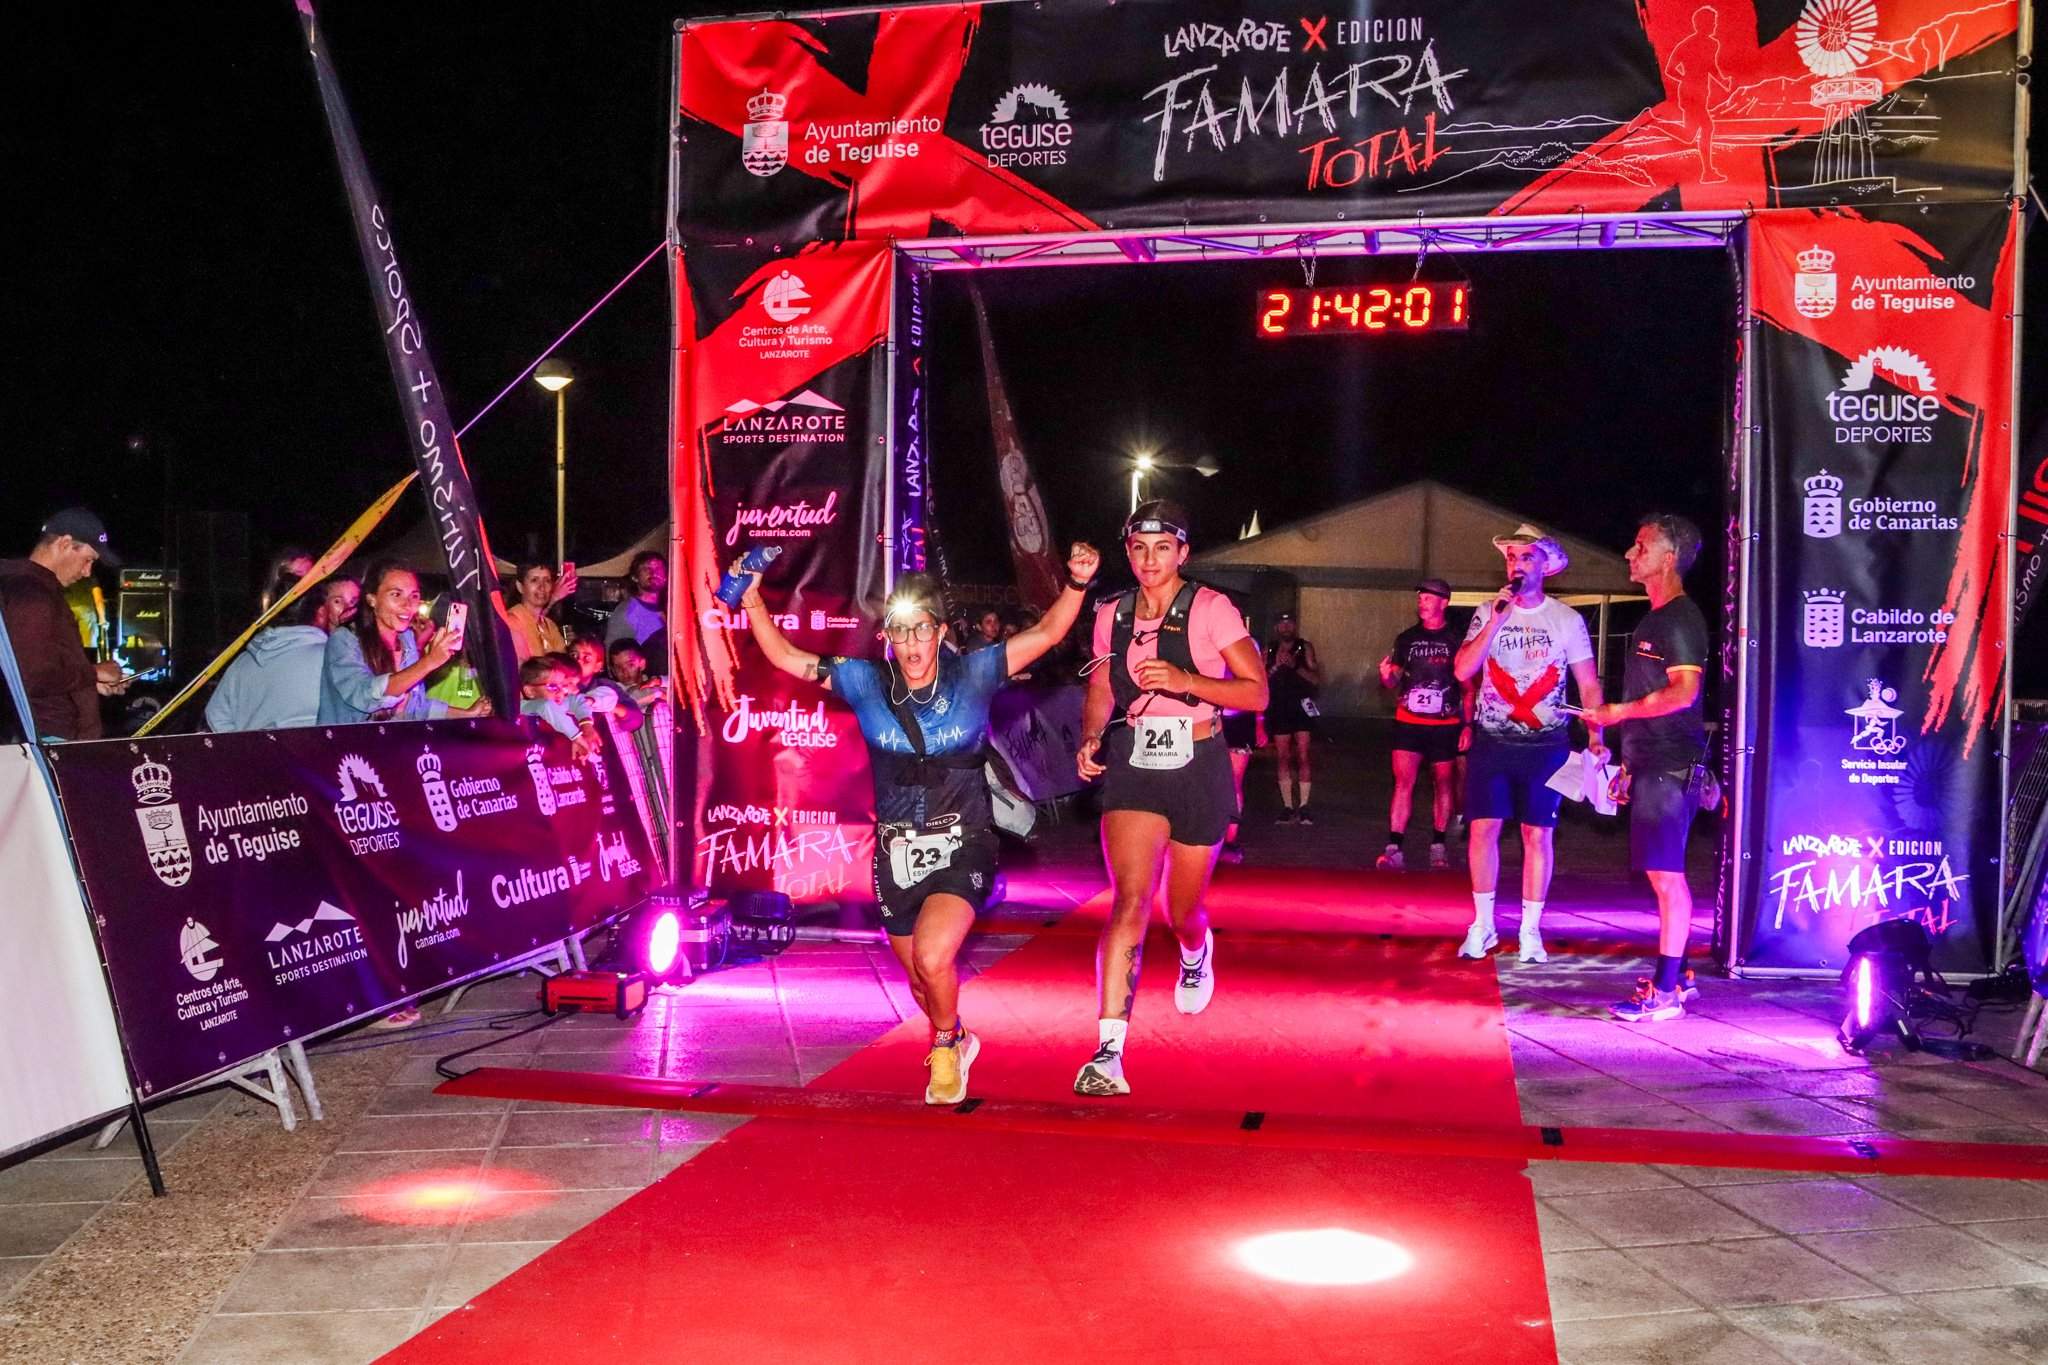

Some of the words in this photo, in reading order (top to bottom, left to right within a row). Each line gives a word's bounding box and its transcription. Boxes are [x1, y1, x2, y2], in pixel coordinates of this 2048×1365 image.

[1165, 18, 1291, 57] LANZAROTE
[1301, 16, 1328, 50] X
[1337, 17, 1423, 44] EDICION
[1143, 38, 1468, 181] FAMARA
[804, 115, 941, 141] Ayuntamiento
[805, 143, 831, 164] de
[836, 139, 919, 162] Teguise
[987, 149, 1067, 168] DEPORTES
[1299, 112, 1451, 190] TOTAL
[1851, 274, 1976, 291] Ayuntamiento
[1851, 295, 1875, 310] de
[1880, 294, 1955, 313] Teguise
[738, 337, 778, 348] Cultura
[779, 338, 785, 348] y
[787, 335, 833, 346] Turismo
[742, 326, 784, 337] Centros
[785, 325, 800, 335] de
[801, 325, 828, 335] Arte,
[759, 350, 810, 359] LANZAROTE
[723, 415, 845, 432] LANZAROTE
[723, 435, 764, 444] SPORTS
[768, 433, 845, 443] DESTINATION
[1835, 427, 1932, 443] DEPORTES
[1849, 497, 1936, 513] Gobierno
[726, 491, 836, 546] juventud
[1848, 515, 1871, 530] de
[1876, 514, 1958, 531] Canarias
[749, 528, 811, 538] canaria.com
[703, 608, 799, 631] Culra
[1851, 609, 1925, 624] Cabildo
[1929, 609, 1954, 624] de
[1498, 634, 1554, 656] FAMARA
[1851, 628, 1947, 643] Lanzarote
[1417, 694, 1432, 705] 21
[723, 694, 829, 744] Juventud
[1145, 729, 1174, 749] 24
[1841, 759, 1876, 770] Servicio
[1878, 759, 1908, 770] Insular
[449, 776, 501, 799] Gobierno
[1849, 773, 1860, 784] de
[1861, 773, 1899, 785] Deportes
[198, 794, 308, 835] Ayuntamiento
[456, 802, 470, 820] de
[471, 793, 518, 818] Canarias
[708, 804, 771, 825] LANZAROTE
[774, 806, 788, 826] X
[792, 811, 837, 824] EDICION
[205, 837, 230, 865] de
[229, 827, 301, 861] Teguise
[350, 831, 400, 856] DEPORTES
[1783, 834, 1863, 858] LANZAROTE
[1867, 836, 1884, 858] X
[1889, 840, 1942, 856] EDICION
[698, 824, 860, 887] FAMARA
[911, 848, 942, 868] 23
[491, 865, 570, 909] Cultura
[774, 868, 853, 900] TOTAL
[1770, 854, 1971, 929] FAMARA
[395, 869, 469, 969] juventud
[268, 926, 364, 970] LANZAROTE
[414, 928, 461, 950] canaria.com
[275, 966, 311, 985] SPORTS
[312, 947, 368, 976] DESTINATION
[176, 985, 212, 1006] Centros
[211, 982, 224, 995] de
[223, 975, 243, 992] Arte,
[177, 999, 211, 1021] Cultura
[210, 1001, 218, 1016] y
[216, 989, 249, 1009] Turismo
[200, 1009, 238, 1031] LANZAROTE
